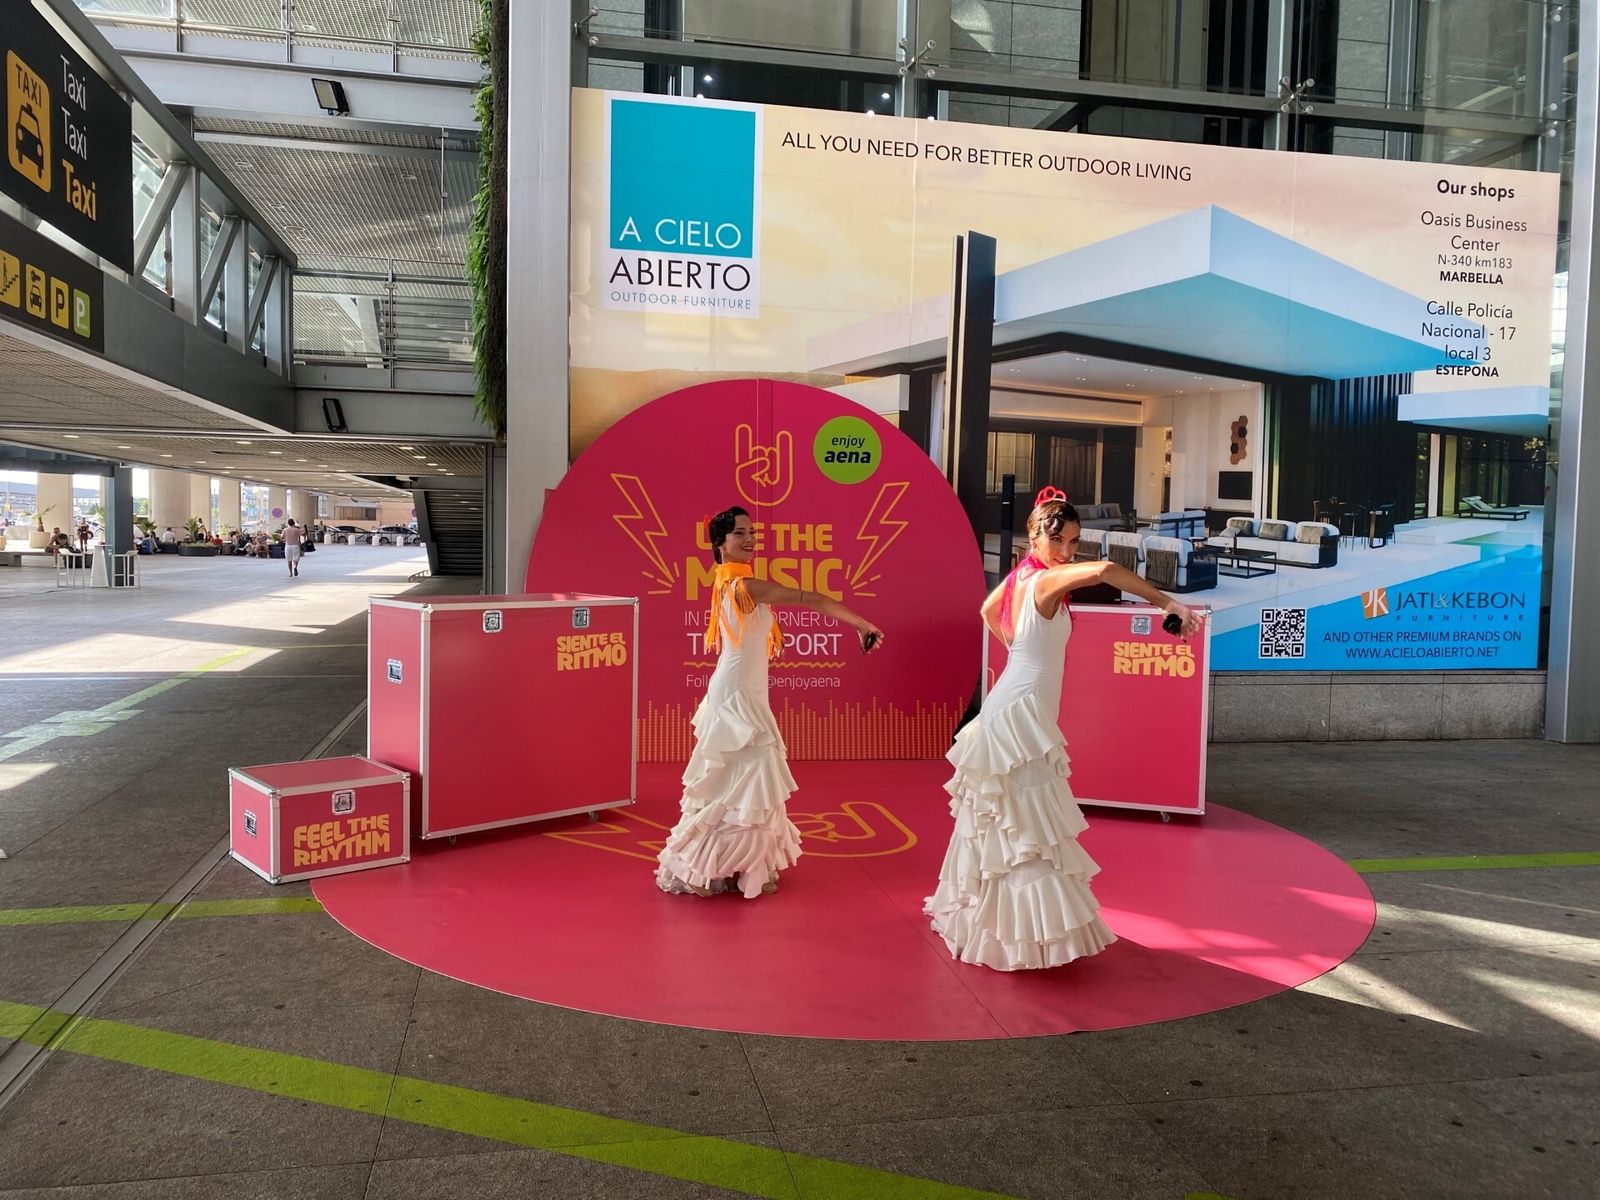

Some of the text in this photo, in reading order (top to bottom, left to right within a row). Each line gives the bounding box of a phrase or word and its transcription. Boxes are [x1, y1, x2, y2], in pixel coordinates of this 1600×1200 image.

[15, 63, 42, 108] TAXI
[60, 54, 86, 110] Taxi
[61, 106, 87, 160] Taxi
[782, 131, 1192, 181] ALL YOU NEED FOR BETTER OUTDOOR LIVING
[62, 158, 97, 221] Taxi
[1437, 179, 1515, 201] Our shops
[1420, 210, 1527, 232] Oasis Business
[619, 216, 742, 249] A CIELO
[1451, 234, 1500, 252] Center
[1437, 254, 1513, 269] N-340 km183
[609, 256, 750, 291] ABIERTO
[1439, 271, 1503, 285] MARBELLA
[55, 287, 85, 327] P P
[611, 291, 751, 309] OUTDOOR FURNITURE
[1426, 300, 1513, 319] Calle Policía
[1421, 322, 1485, 339] Nacional
[1499, 326, 1516, 341] 17
[1445, 344, 1491, 361] local 3
[1435, 364, 1499, 378] ESTEPONA
[831, 435, 866, 448] enjoy
[824, 451, 871, 463] aena
[771, 523, 833, 552] THE
[684, 611, 699, 627] IN
[556, 632, 626, 653] SIENTE EL
[1323, 630, 1522, 643] AND OTHER PREMIUM BRANDS ON
[557, 643, 627, 671] RITMO
[1113, 641, 1195, 658] SIENTE EL
[1346, 646, 1500, 659] WWW.ACIELOABIERTO.NET
[1113, 654, 1195, 678] RITMO
[768, 674, 841, 690] @enjoyaena
[293, 814, 390, 850] FEEL THE
[293, 831, 390, 867] RHYTHM
